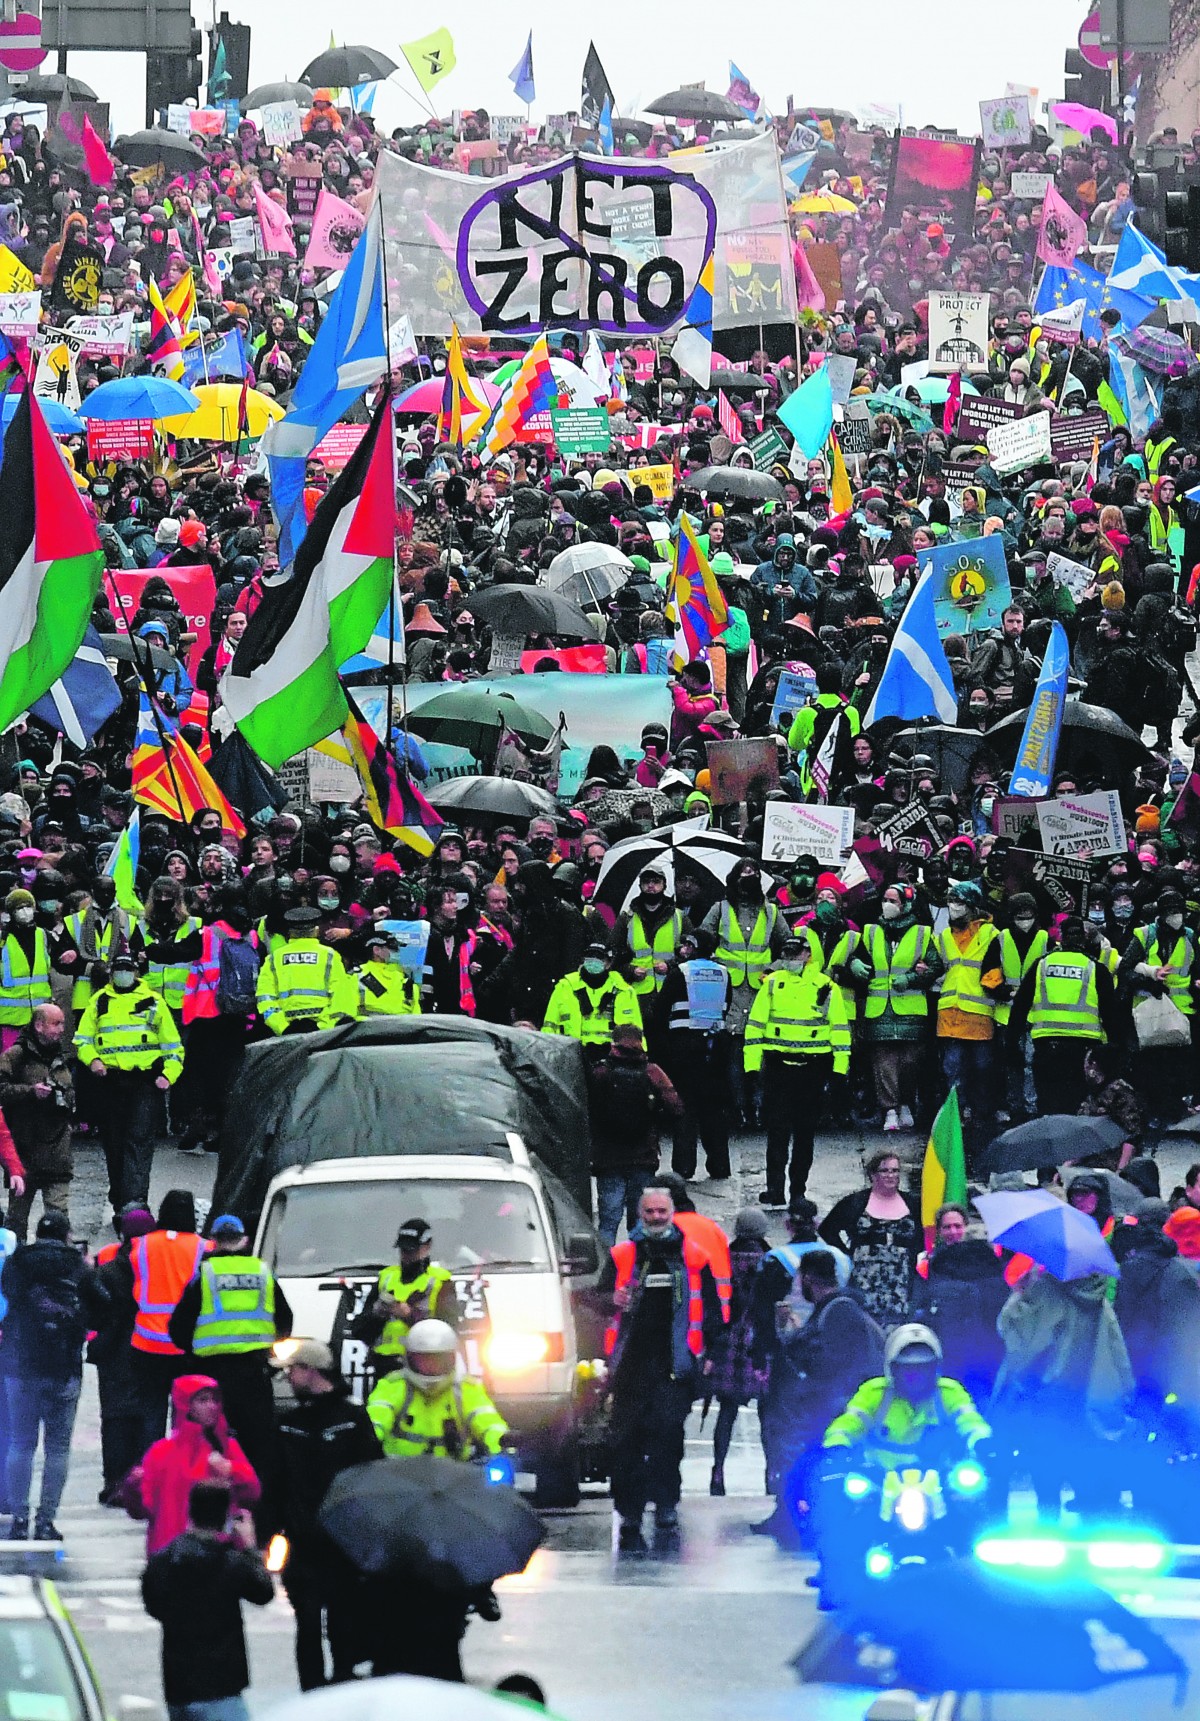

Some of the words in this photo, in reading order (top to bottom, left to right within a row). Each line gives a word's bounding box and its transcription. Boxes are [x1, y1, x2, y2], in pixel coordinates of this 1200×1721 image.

[263, 106, 293, 123] Save
[499, 172, 674, 251] NET
[605, 208, 619, 217] NOT
[631, 203, 652, 213] PENNY
[612, 215, 630, 225] MORE
[635, 212, 649, 220] FOR
[728, 235, 746, 246] NO
[475, 252, 685, 332] ZERO
[939, 300, 981, 310] PROTECT
[941, 350, 953, 360] NO
[962, 409, 987, 419] WORLD
[977, 403, 989, 411] WE
[989, 405, 1001, 414] LET
[1002, 407, 1015, 416] THE
[644, 473, 671, 481] CLIMATE
[961, 471, 974, 479] THE
[943, 555, 985, 577] SOS
[879, 831, 893, 852] 4
[889, 805, 928, 838] AFRICA
[771, 841, 785, 860] 4
[786, 844, 834, 860] AFRICA
[1066, 836, 1111, 854] AFRICA
[1032, 860, 1046, 881] 4
[1046, 863, 1091, 883] AFRICA
[283, 953, 317, 965] POLICE
[1047, 965, 1082, 978] POLICE
[217, 1275, 261, 1290] POLICE
